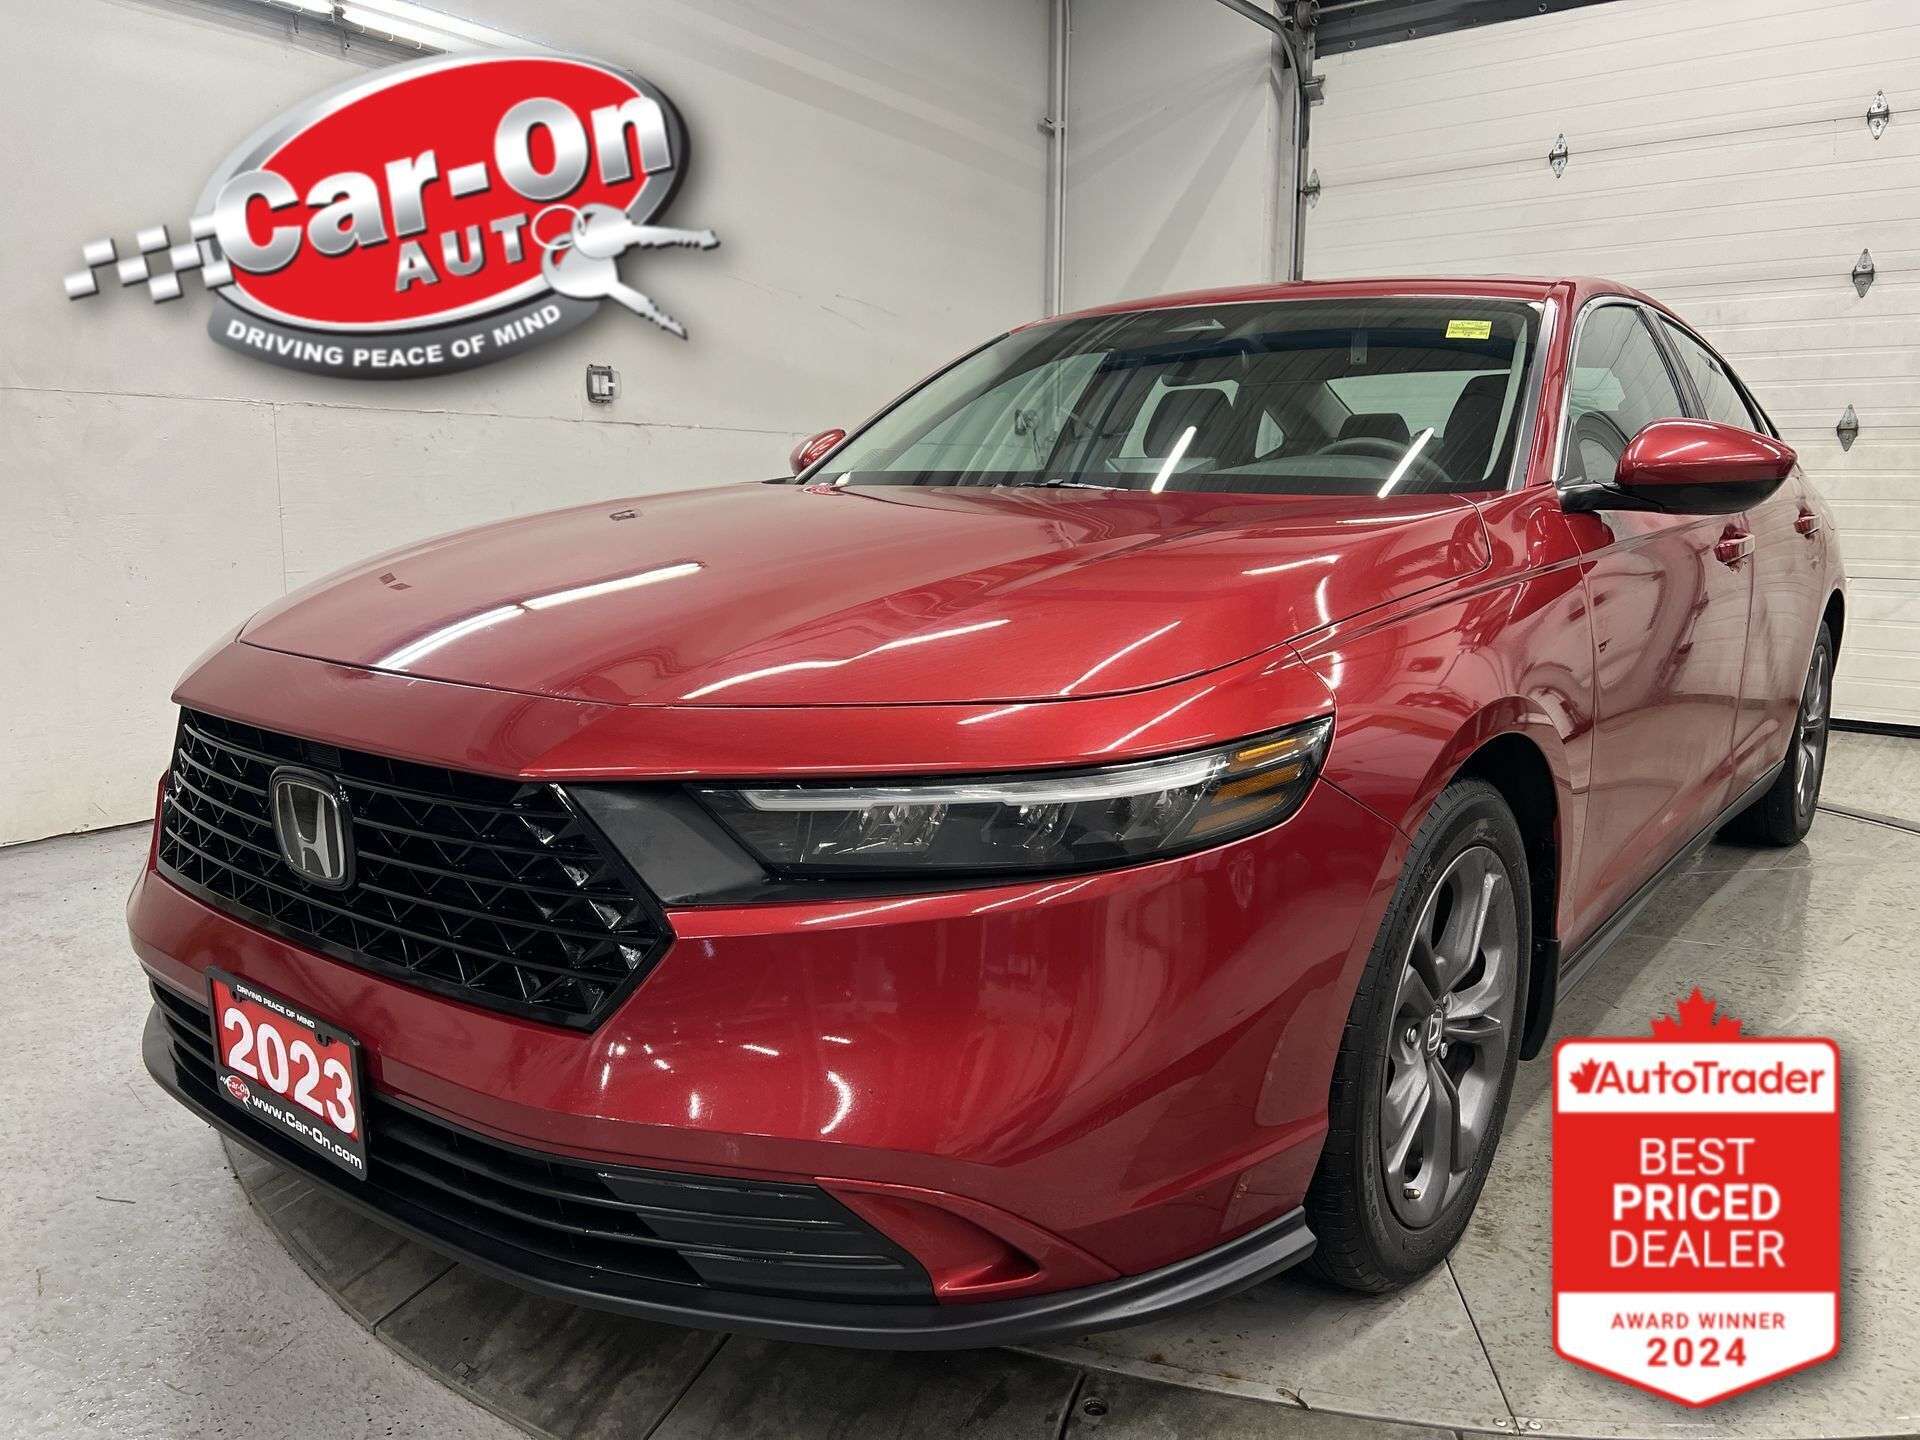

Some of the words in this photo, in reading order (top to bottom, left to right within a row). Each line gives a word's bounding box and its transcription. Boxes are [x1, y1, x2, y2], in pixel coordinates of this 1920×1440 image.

[236, 984, 263, 1003] DRIVING
[263, 997, 285, 1015] PEACE
[285, 1008, 296, 1018] OF
[296, 1013, 316, 1029] MIND
[223, 1007, 356, 1134] 2023
[251, 1095, 363, 1171] www.Car-On.com
